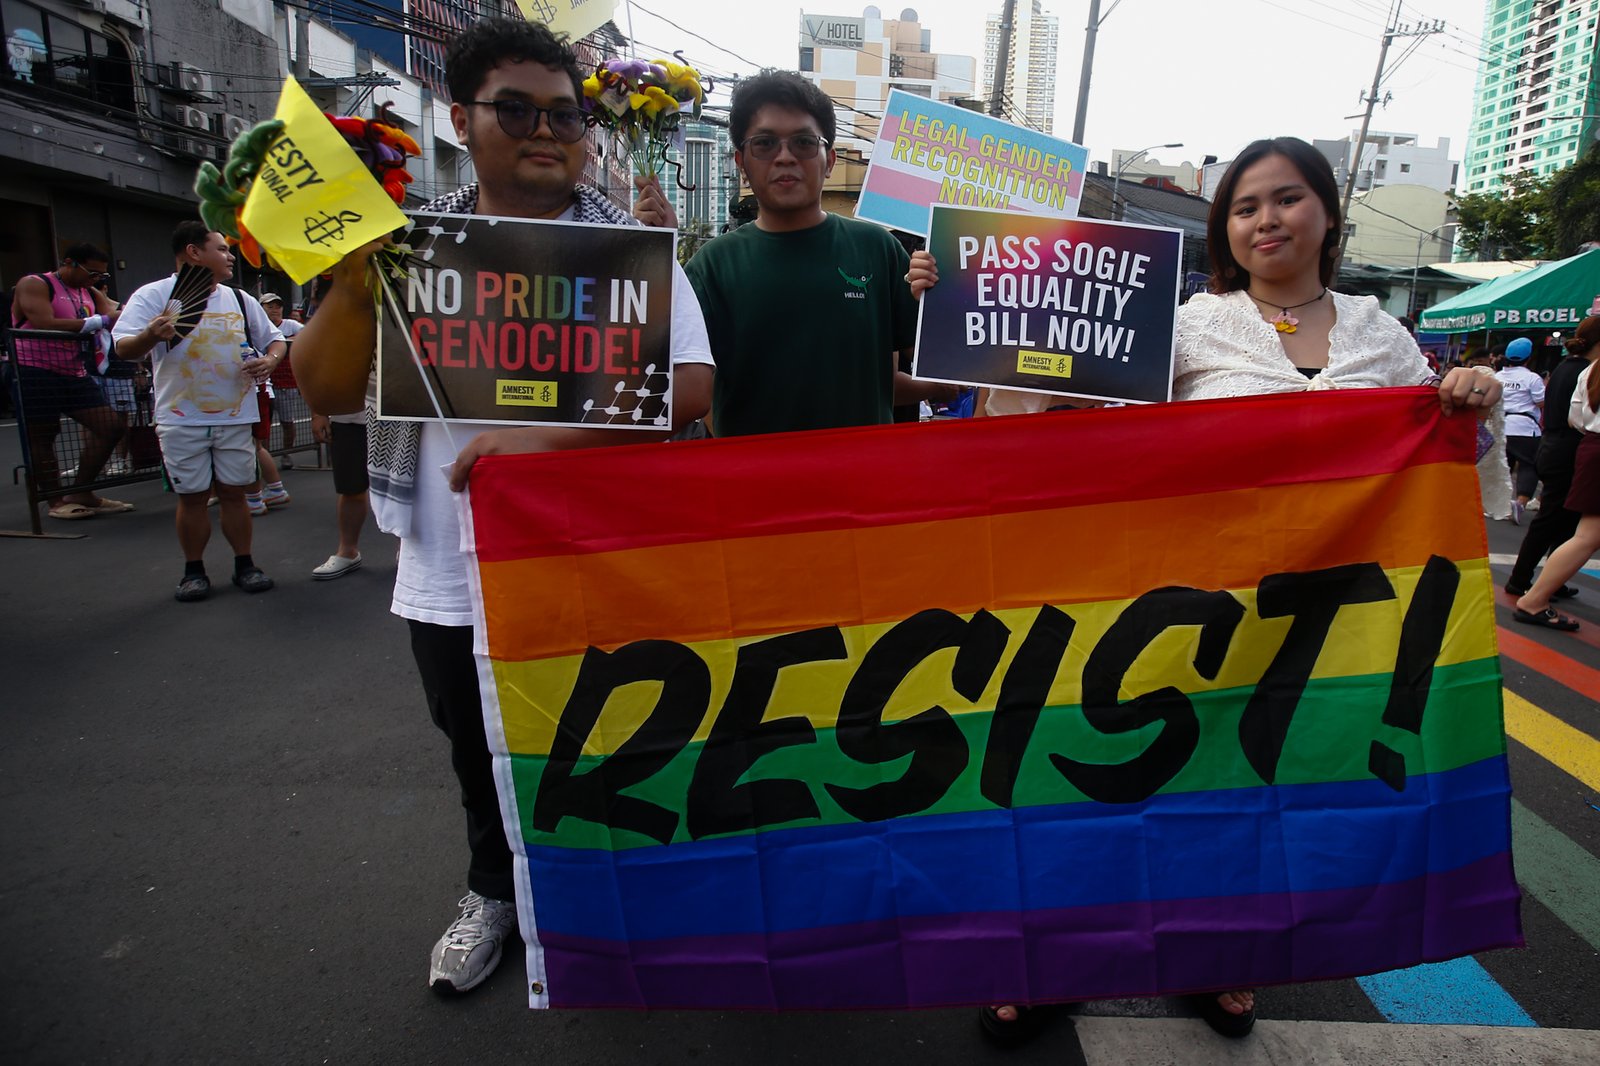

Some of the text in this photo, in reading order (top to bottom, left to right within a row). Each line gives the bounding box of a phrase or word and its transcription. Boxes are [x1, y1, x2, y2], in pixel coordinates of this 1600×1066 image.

[827, 22, 862, 40] HOTEL
[268, 131, 325, 189] ESTY
[891, 135, 1067, 210] RECOGNITION
[898, 110, 1072, 183] LEGAL GENDER
[958, 235, 1150, 289] PASS SOGIE
[407, 267, 648, 324] NO PRIDE IN
[977, 273, 1133, 321] EQUALITY
[1494, 309, 1520, 324] PB
[1525, 308, 1580, 323] ROEL
[410, 317, 641, 376] GENOCIDE!
[965, 312, 1135, 363] BILL NOW!
[1023, 355, 1052, 366] AMNESTY
[502, 385, 535, 394] AMNESTY
[532, 554, 1460, 846] RESIST!
